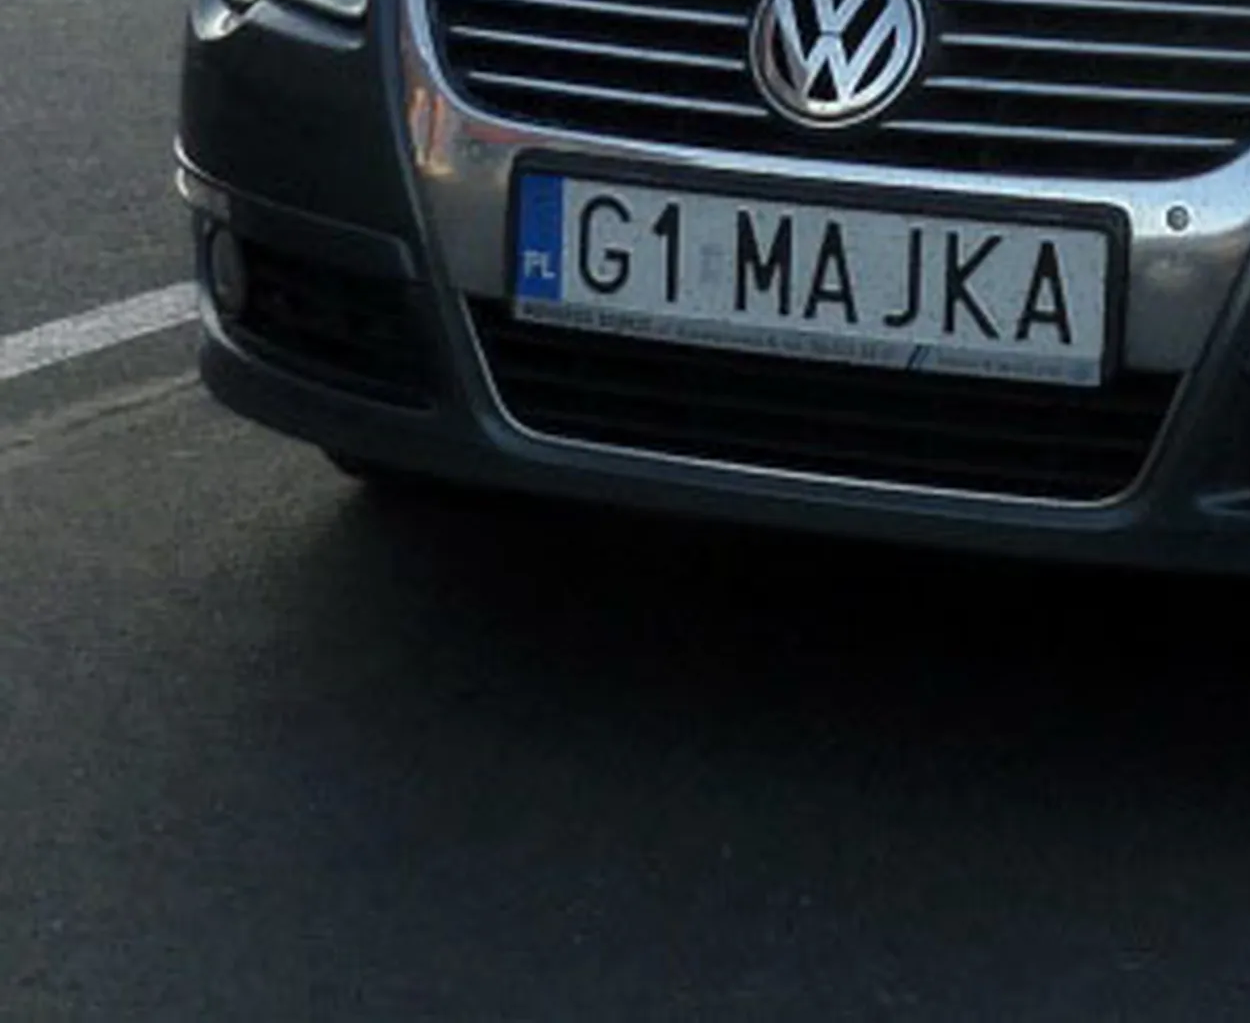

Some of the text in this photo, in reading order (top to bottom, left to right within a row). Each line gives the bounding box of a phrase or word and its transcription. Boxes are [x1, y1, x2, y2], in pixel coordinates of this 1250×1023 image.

[523, 250, 556, 279] PL
[579, 194, 681, 303] G1
[735, 208, 1073, 346] MAJKA
